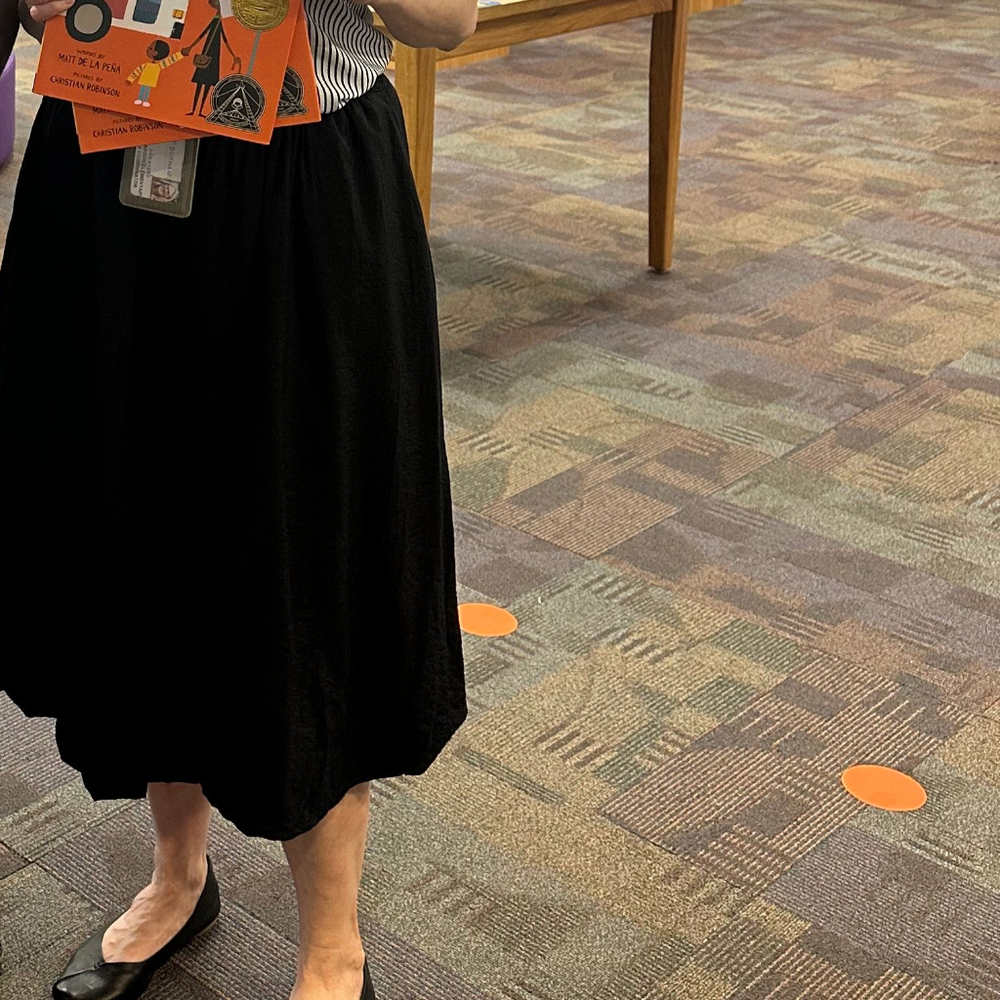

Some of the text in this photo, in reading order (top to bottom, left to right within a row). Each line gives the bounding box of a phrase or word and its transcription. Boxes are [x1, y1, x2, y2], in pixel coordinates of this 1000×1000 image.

[58, 53, 121, 74] MATT DE LA PEÑA
[50, 75, 121, 98] CHRISTIAN ROBINSON
[92, 121, 164, 138] CHRISTIAN ROBINSON
